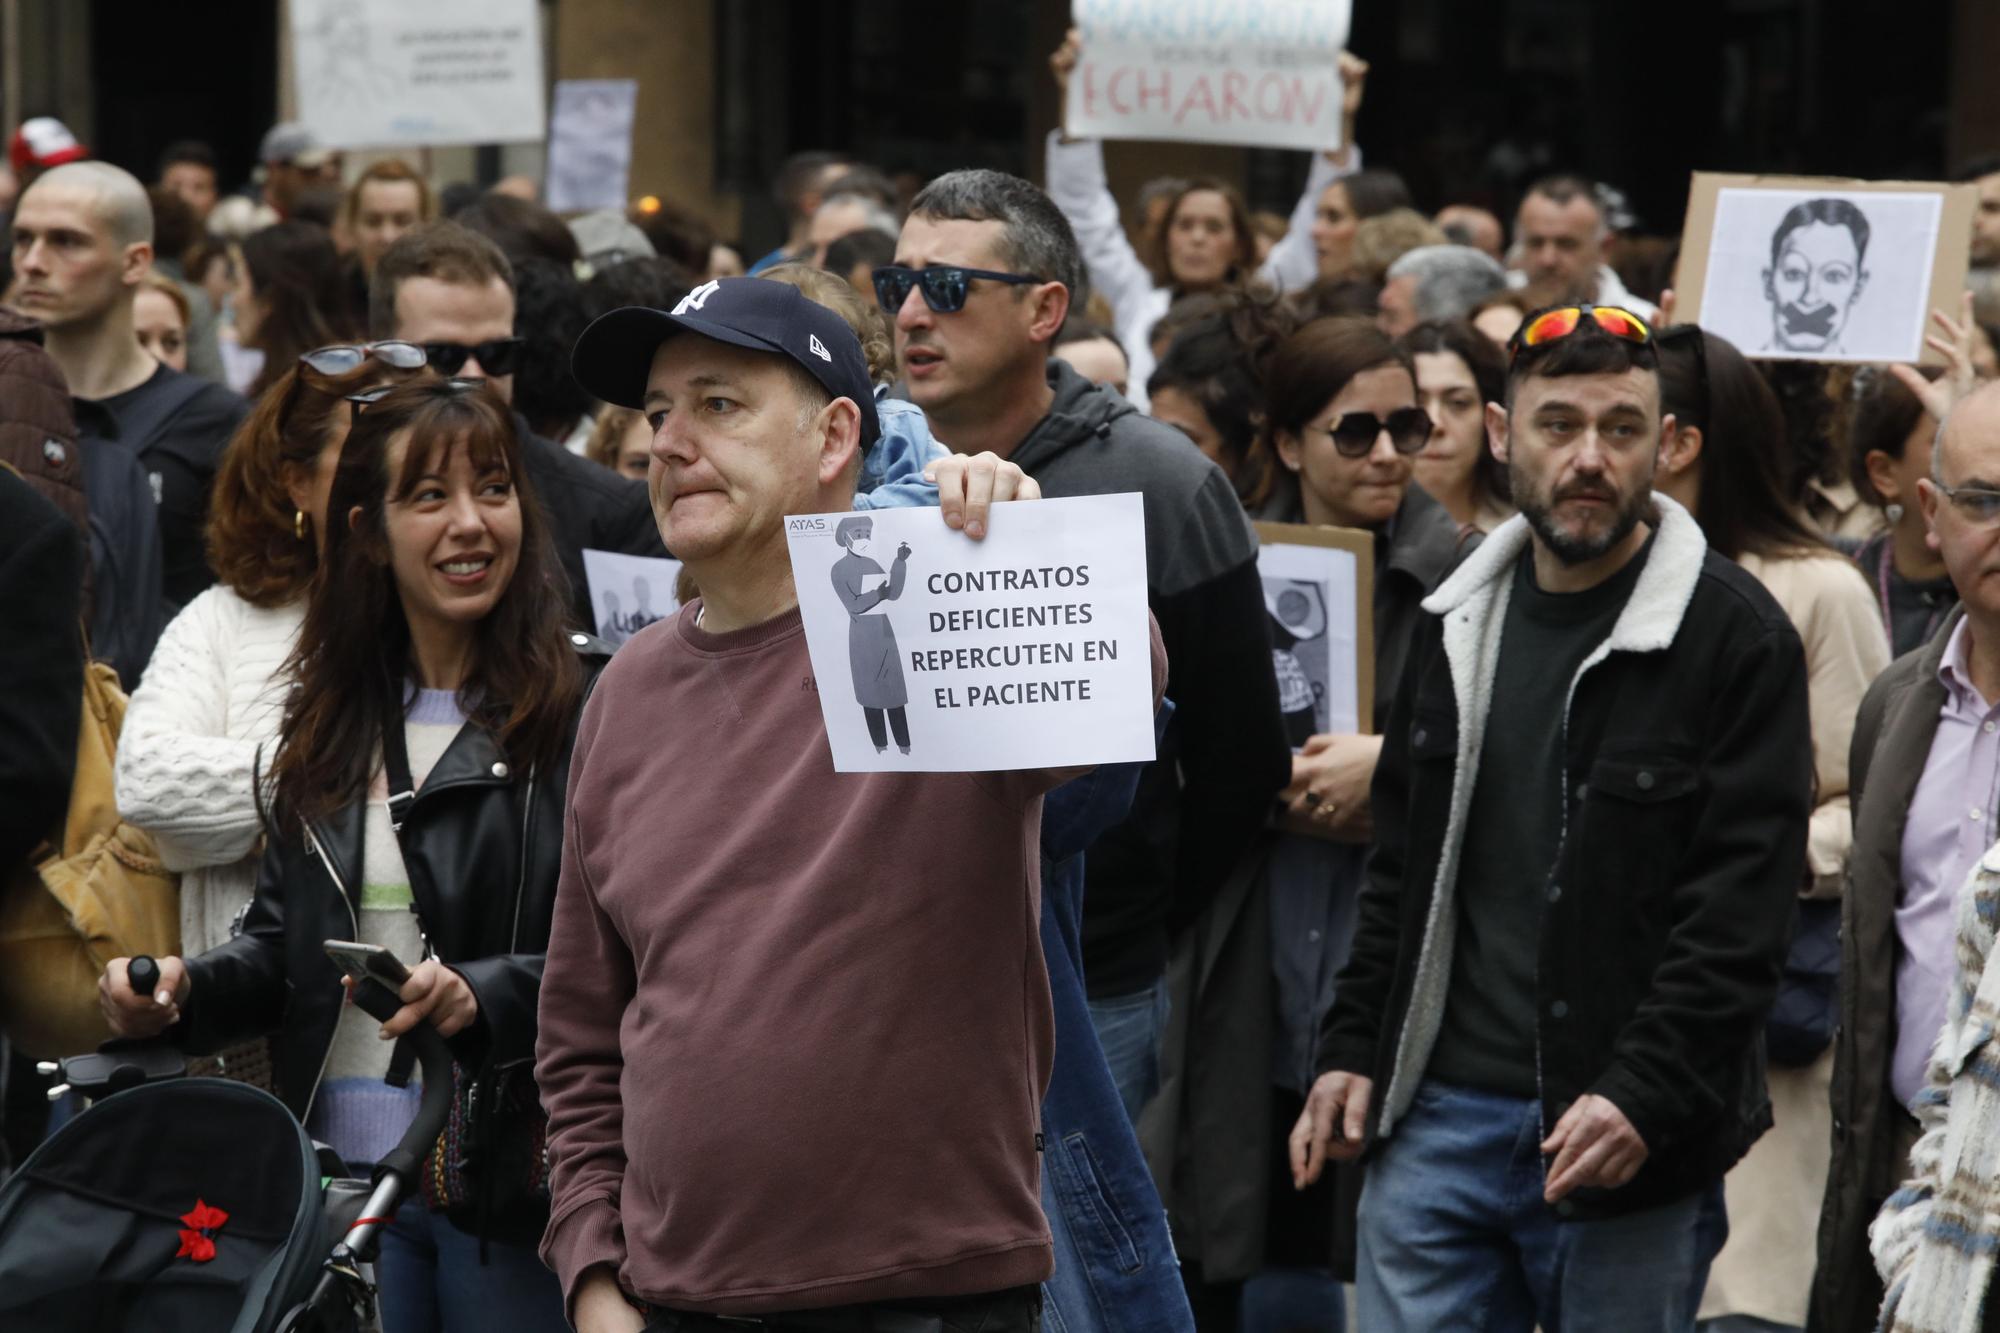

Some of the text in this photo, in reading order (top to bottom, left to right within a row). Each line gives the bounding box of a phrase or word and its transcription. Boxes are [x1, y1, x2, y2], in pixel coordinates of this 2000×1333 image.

[1083, 62, 1325, 127] ECHARON
[790, 518, 826, 531] ATAS
[927, 565, 1090, 595] CONTRATOS
[929, 603, 1093, 633] DEFICIENTES
[911, 639, 1118, 672] REPERCUTEN EN
[934, 679, 1091, 709] EL PACIENTE
